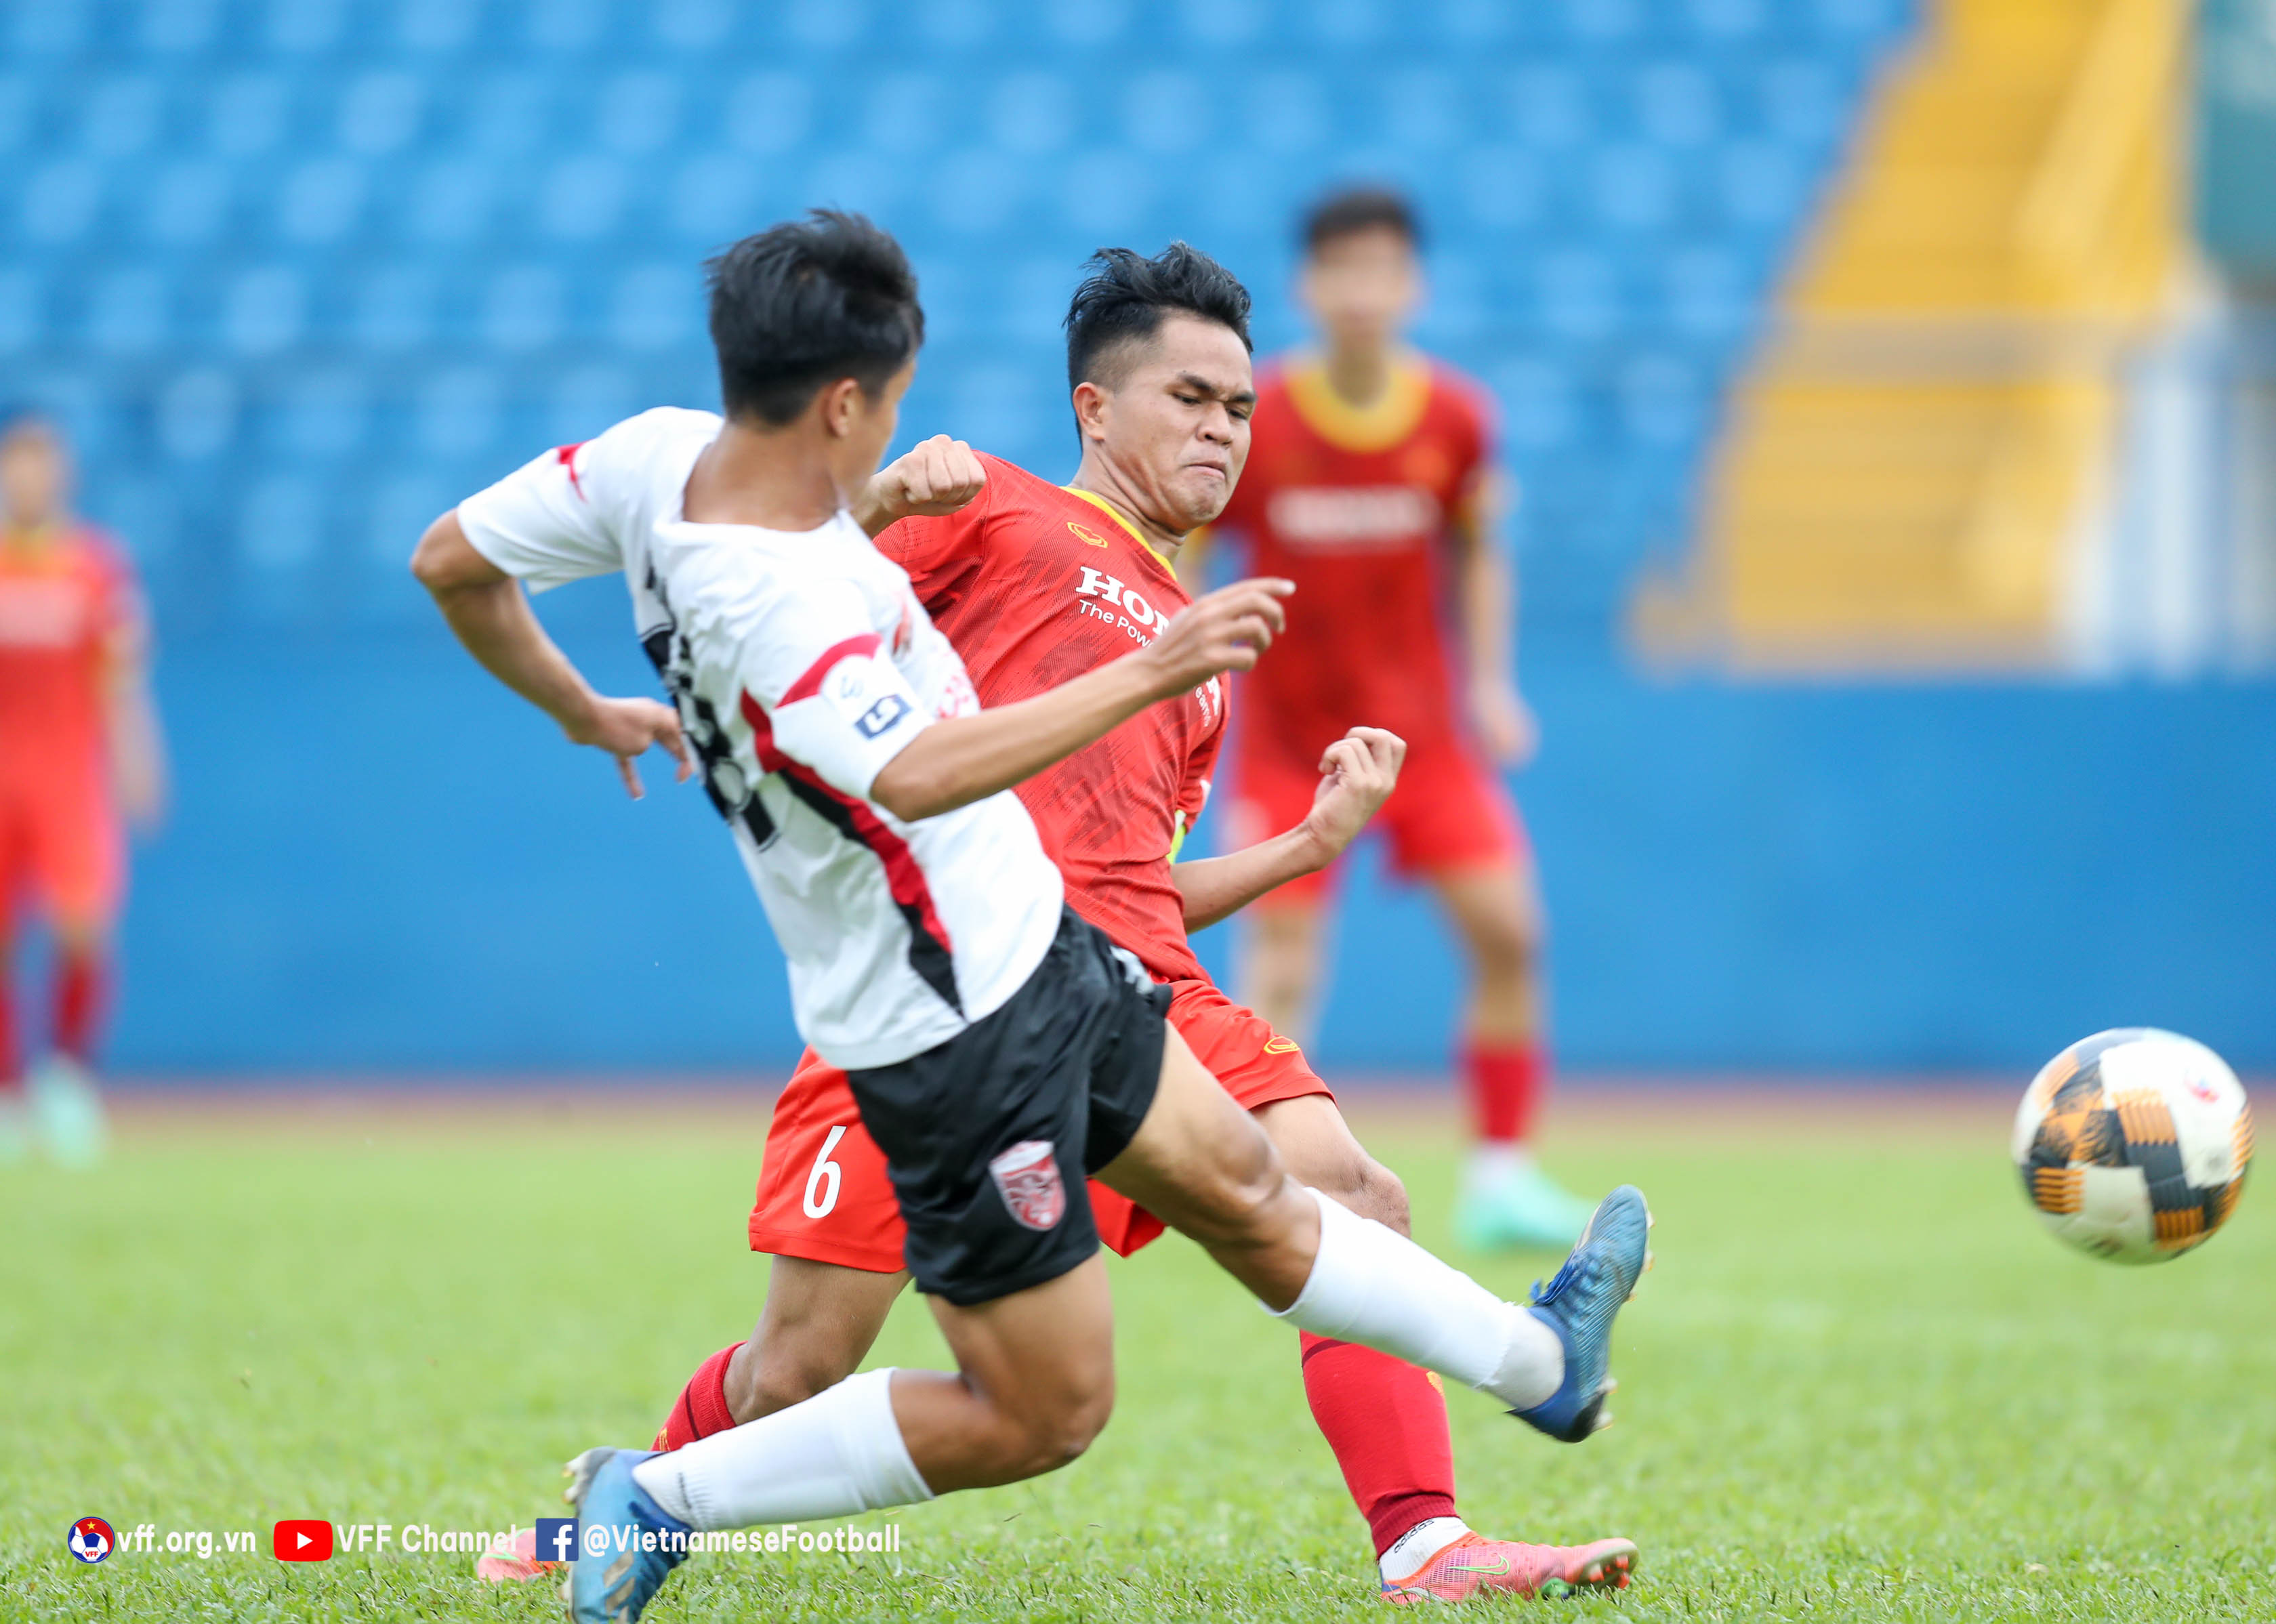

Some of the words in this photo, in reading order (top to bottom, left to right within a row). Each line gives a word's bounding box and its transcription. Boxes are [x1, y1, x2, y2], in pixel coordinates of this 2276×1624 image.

[1079, 599, 1113, 624] The
[1117, 618, 1153, 648] Pow
[802, 1125, 847, 1219] 6
[1394, 1519, 1434, 1554] adidas
